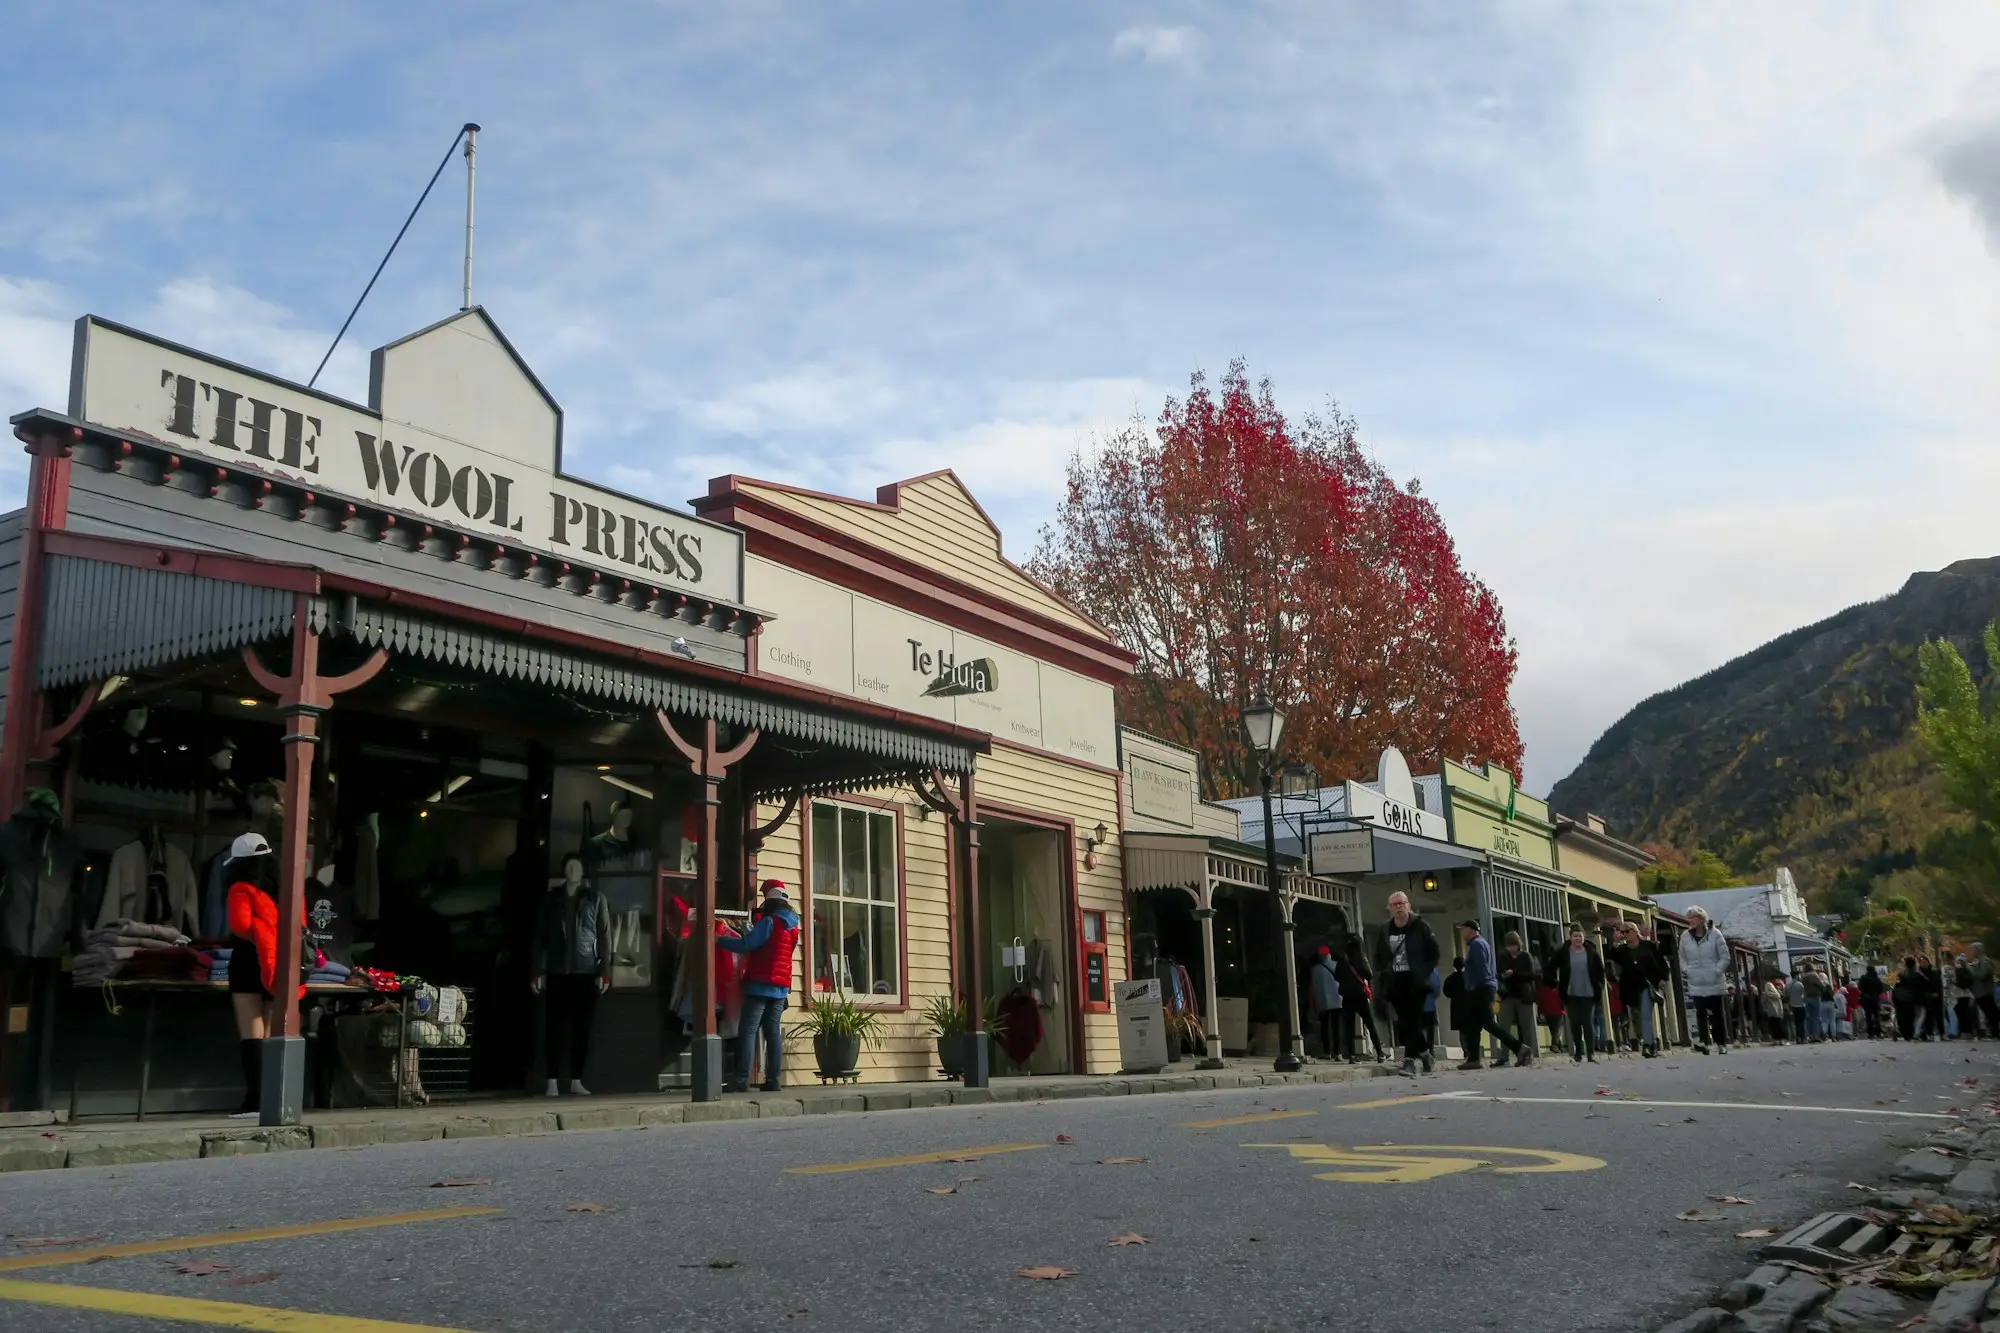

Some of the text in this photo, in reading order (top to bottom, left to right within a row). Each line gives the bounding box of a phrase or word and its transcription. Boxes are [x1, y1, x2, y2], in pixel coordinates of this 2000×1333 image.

[160, 369, 704, 583] THE WOOL PRESS
[769, 646, 812, 676] Clothing
[907, 638, 986, 692] Te Huia
[857, 673, 889, 694] Leather
[1011, 719, 1040, 738] Knitwear
[1069, 736, 1097, 756] Jewellery
[1383, 800, 1422, 836] GOALS
